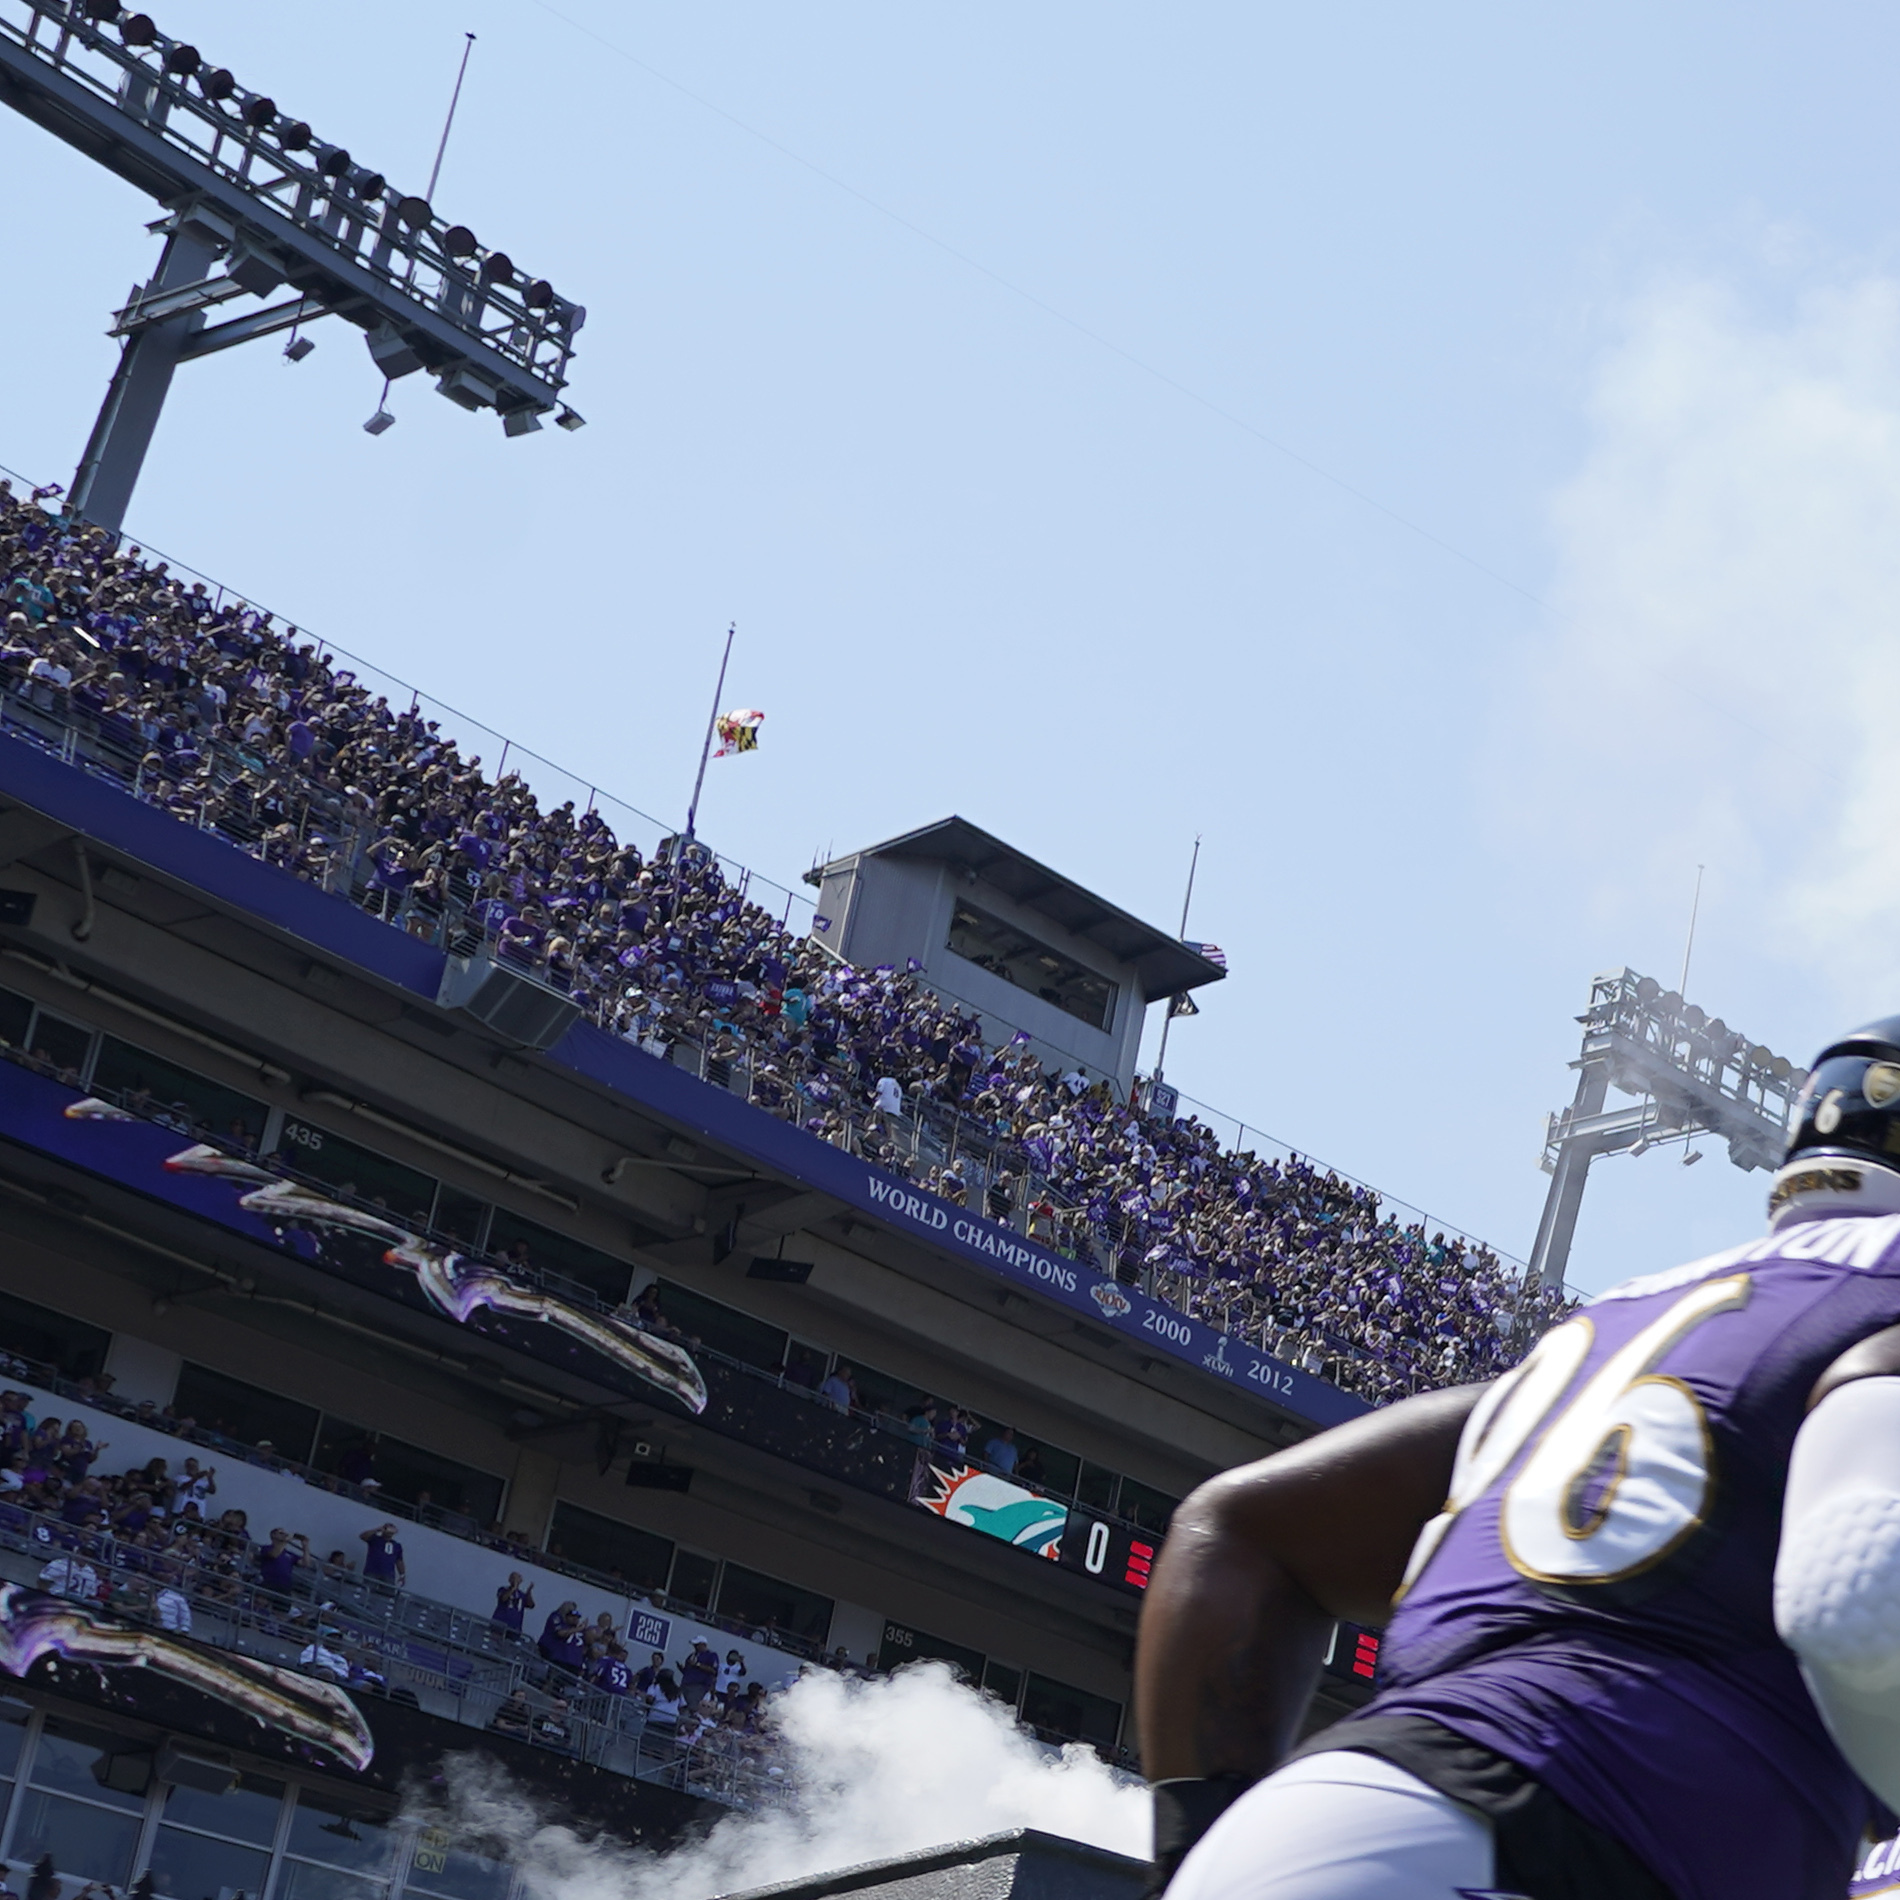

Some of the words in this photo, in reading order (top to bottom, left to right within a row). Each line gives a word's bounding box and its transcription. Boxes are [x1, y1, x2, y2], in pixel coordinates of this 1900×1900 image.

[284, 1122, 324, 1152] 435
[868, 1174, 949, 1231] WORLD
[952, 1219, 1078, 1294] CHAMPIONS
[1142, 1309, 1192, 1347] 2000
[1202, 1352, 1235, 1378] XLVII
[1246, 1359, 1295, 1397] 2012
[1084, 1521, 1110, 1575] 0
[635, 1614, 664, 1645] 225
[885, 1625, 915, 1649] 355
[611, 1668, 628, 1688] 52
